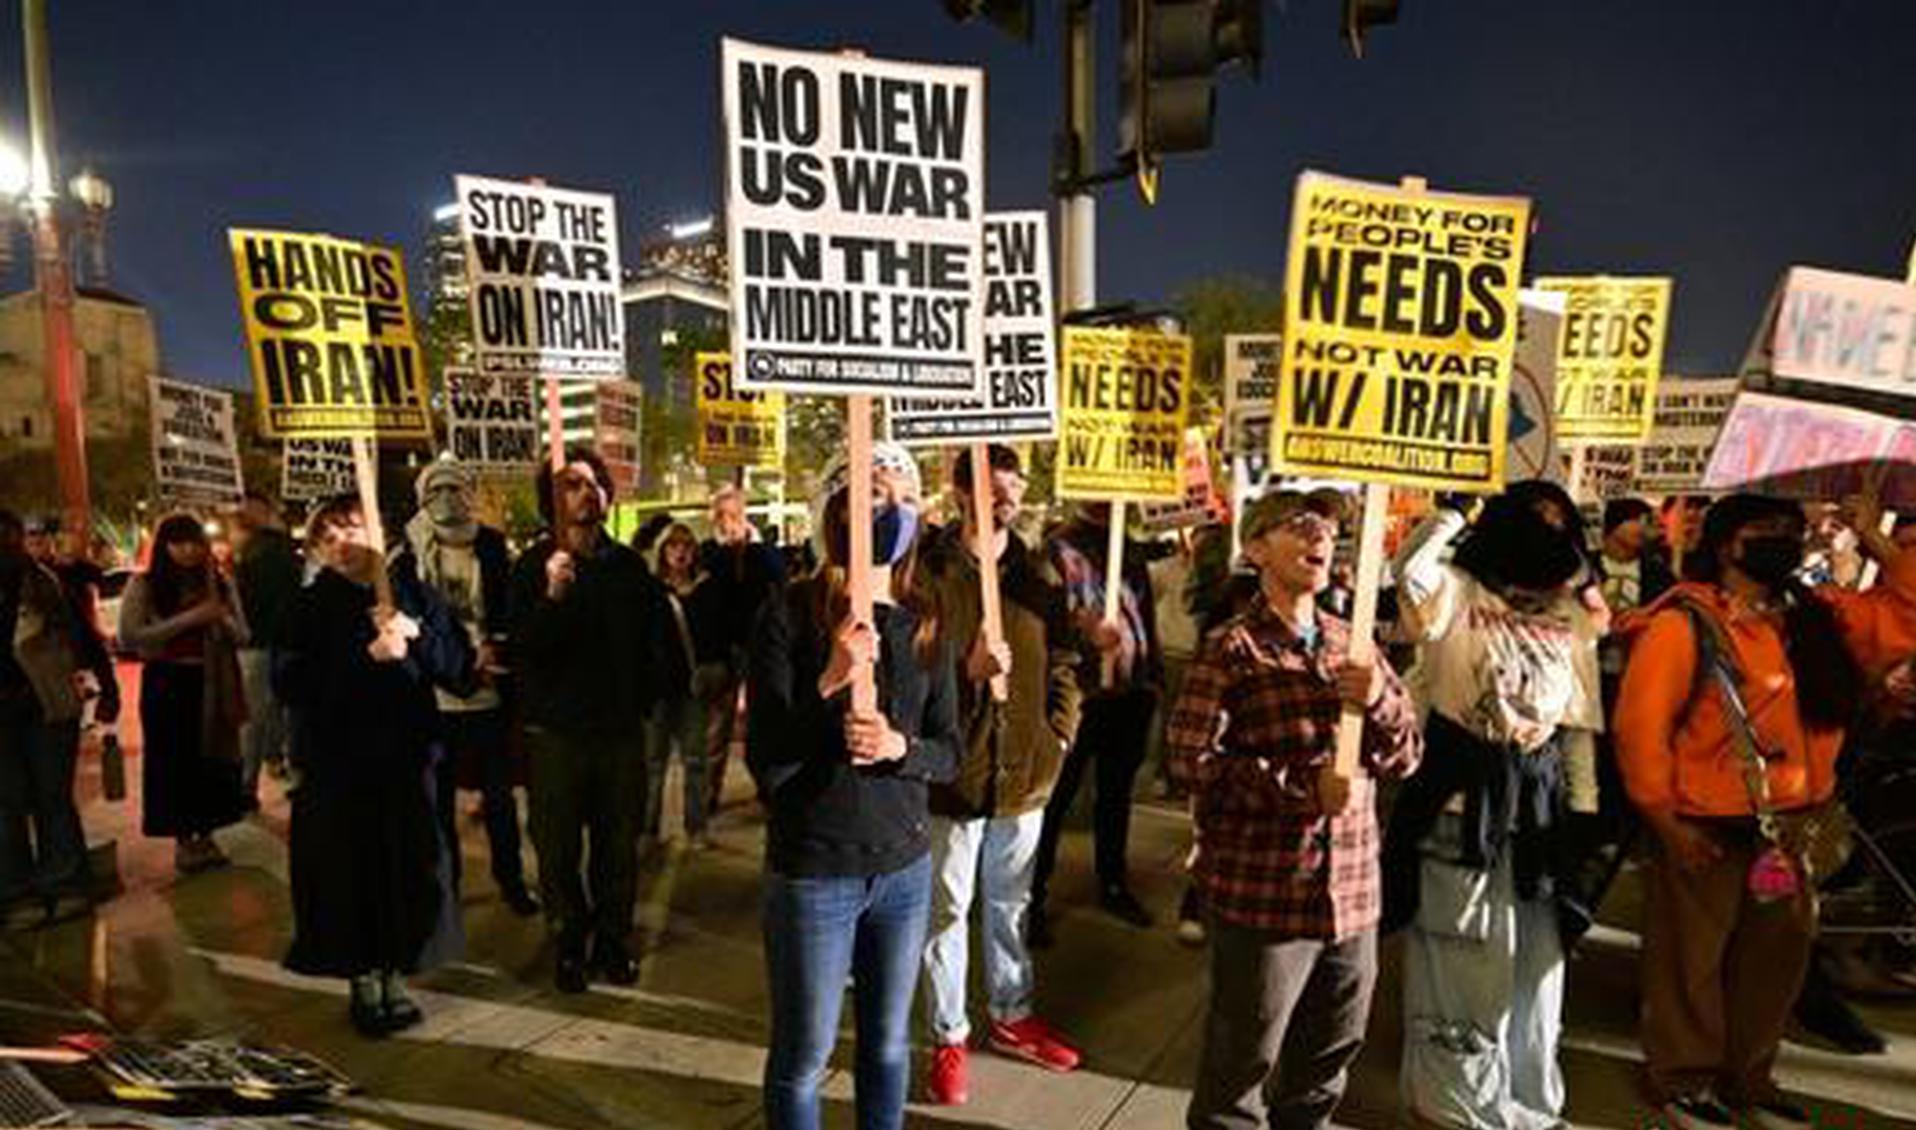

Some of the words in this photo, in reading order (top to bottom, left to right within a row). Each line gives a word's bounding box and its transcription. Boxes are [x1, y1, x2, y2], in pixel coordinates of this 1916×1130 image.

[738, 60, 819, 147] NO
[839, 71, 968, 162] NEW
[740, 145, 827, 211] US
[831, 156, 970, 221] WAR
[468, 190, 545, 235] STOP
[553, 202, 606, 243] THE
[1311, 194, 1434, 226] MONEY
[1441, 210, 1515, 234] FOR
[472, 233, 612, 281] WAR
[743, 228, 822, 281] IN
[830, 235, 971, 291] THE
[983, 221, 1037, 275] EW
[1307, 218, 1512, 260] PEOPLE'S
[244, 237, 399, 301] HANDS
[254, 293, 404, 336] OFF
[478, 283, 529, 347] ON
[533, 286, 620, 350] IRAN!
[984, 279, 1043, 317] AR
[1300, 245, 1507, 342] NEEDS
[745, 284, 881, 346] MIDDLE
[891, 293, 971, 352] EAST
[1562, 312, 1654, 359] EEDS
[260, 338, 420, 406] IRAN!
[985, 333, 1046, 365] HE
[1294, 340, 1387, 366] NOT
[1395, 349, 1499, 379] WAR
[452, 398, 532, 421] WAR
[989, 369, 1048, 408] EAST
[1069, 363, 1182, 414] NEEDS
[1293, 368, 1368, 430] W/
[1382, 376, 1494, 444] IRAN
[1582, 384, 1645, 415] IRAN
[454, 426, 482, 462] ON
[1067, 436, 1104, 467] W/
[1115, 438, 1177, 472] IRAN
